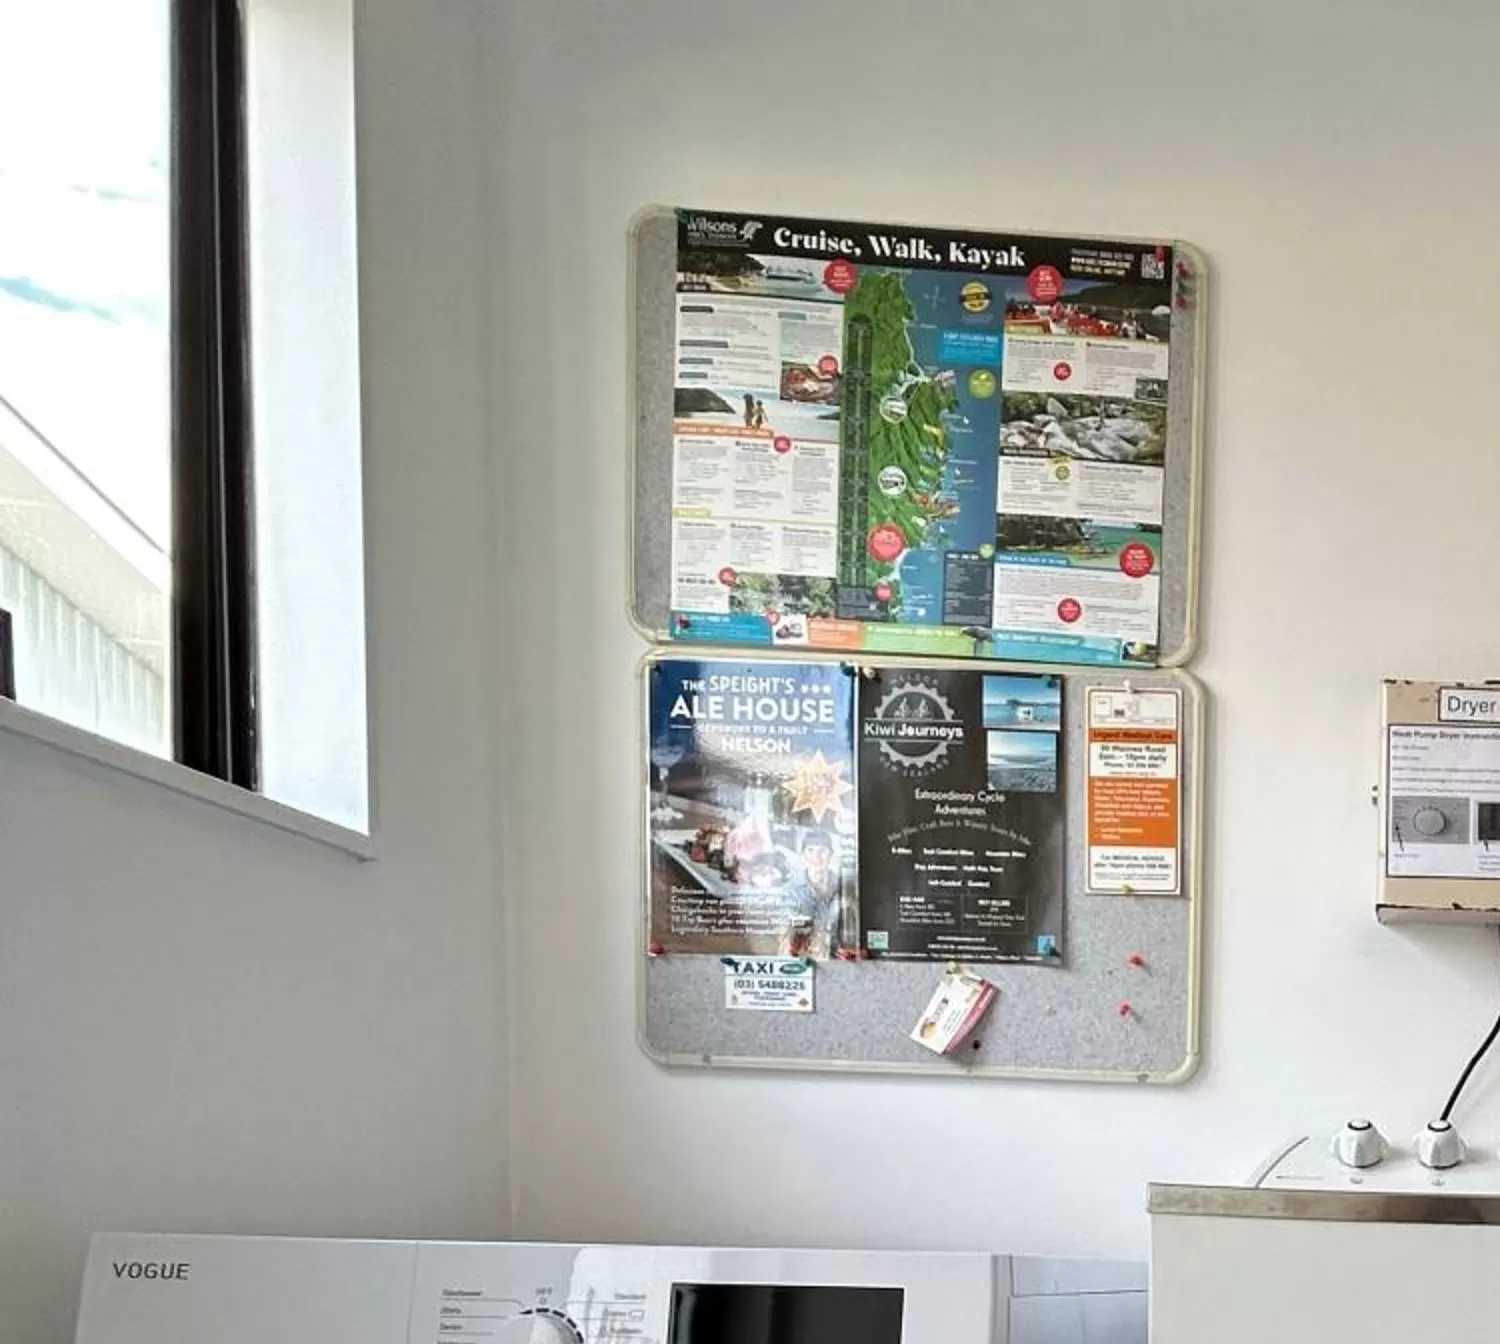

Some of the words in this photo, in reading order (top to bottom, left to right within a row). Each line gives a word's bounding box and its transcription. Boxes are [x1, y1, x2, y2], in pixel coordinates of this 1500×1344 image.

[773, 226, 862, 257] Cruise,
[867, 234, 942, 262] Walk,
[949, 240, 1026, 270] Kayak
[681, 679, 705, 691] THE
[709, 675, 796, 695] SPEIGHT'S
[669, 694, 725, 721] ALE
[733, 695, 836, 724] HOUSE
[1446, 695, 1498, 717] Dryer
[864, 722, 895, 736] Kiwi
[898, 723, 964, 740] Journeys
[721, 736, 792, 753] NELSON
[733, 961, 773, 975] TAXI
[112, 1262, 190, 1281] VOGUE
